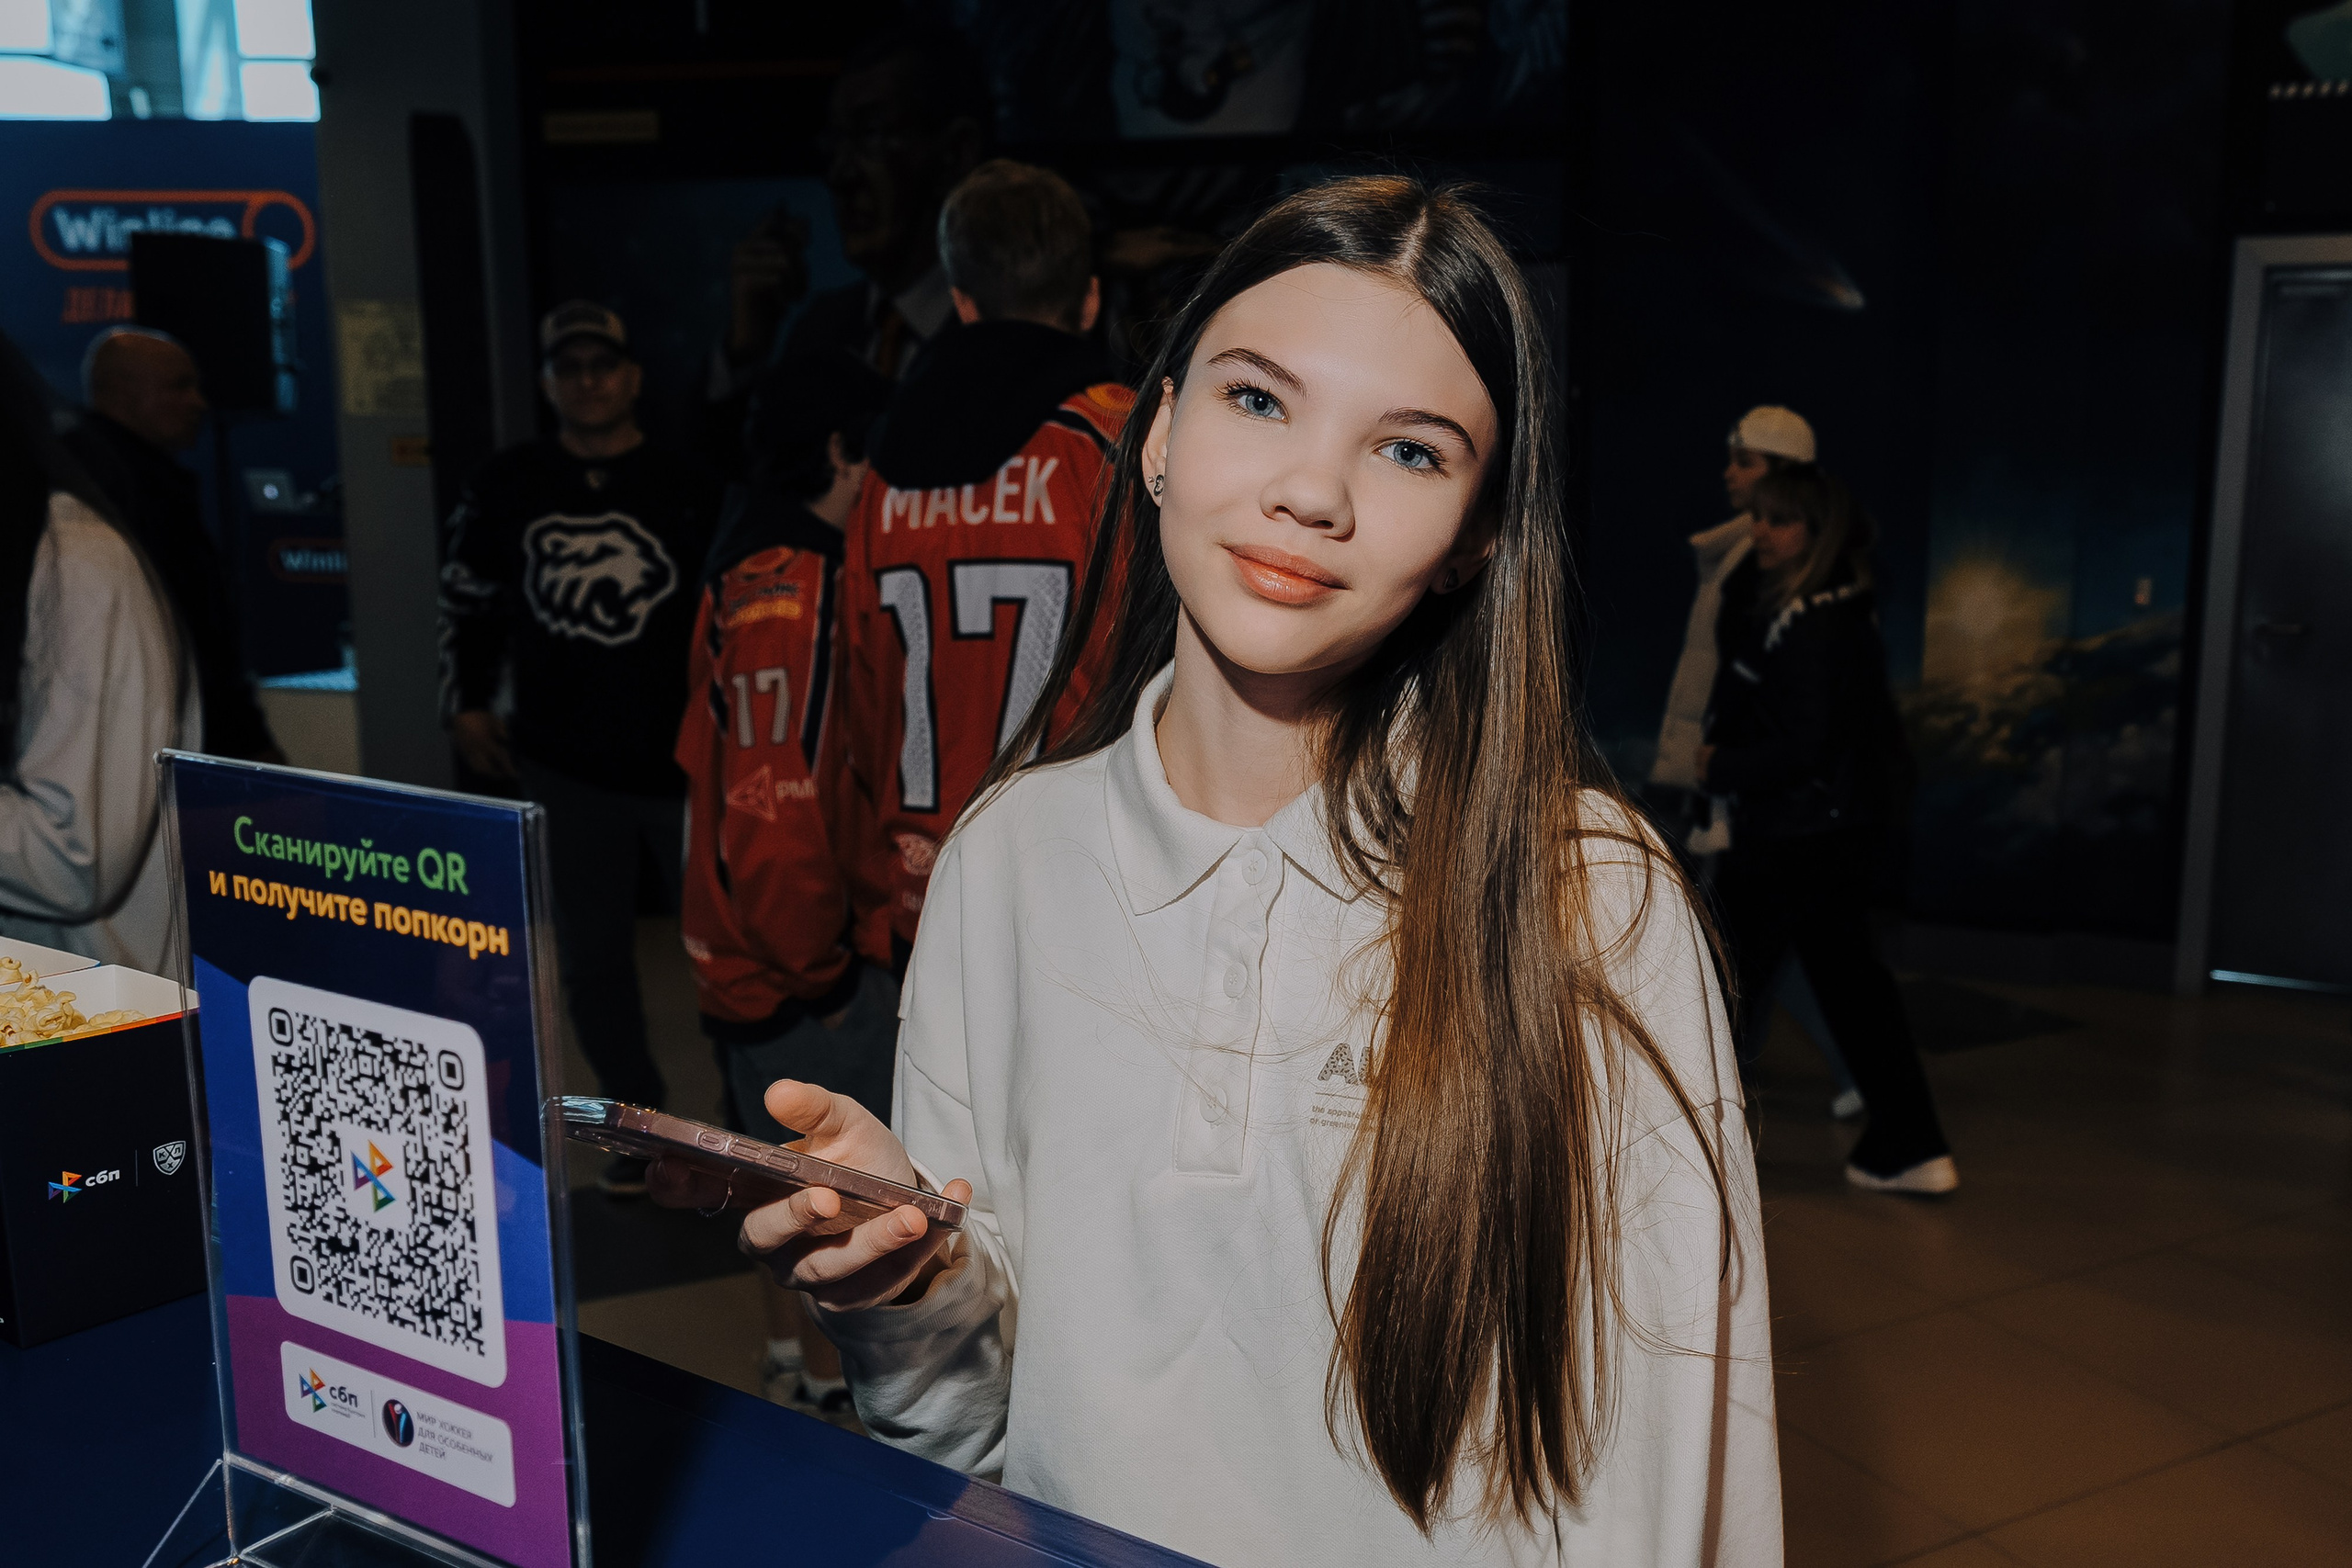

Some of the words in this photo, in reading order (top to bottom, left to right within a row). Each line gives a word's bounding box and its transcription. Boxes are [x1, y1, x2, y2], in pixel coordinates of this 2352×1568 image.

[732, 667, 791, 749] 17
[876, 559, 1075, 813] 17
[234, 816, 410, 883] Сканируйте
[417, 848, 469, 896] QR
[209, 869, 228, 897] и
[233, 874, 368, 926] получите
[374, 901, 510, 960] попкорн
[85, 1168, 120, 1187] сбп
[329, 1385, 358, 1408] сбп
